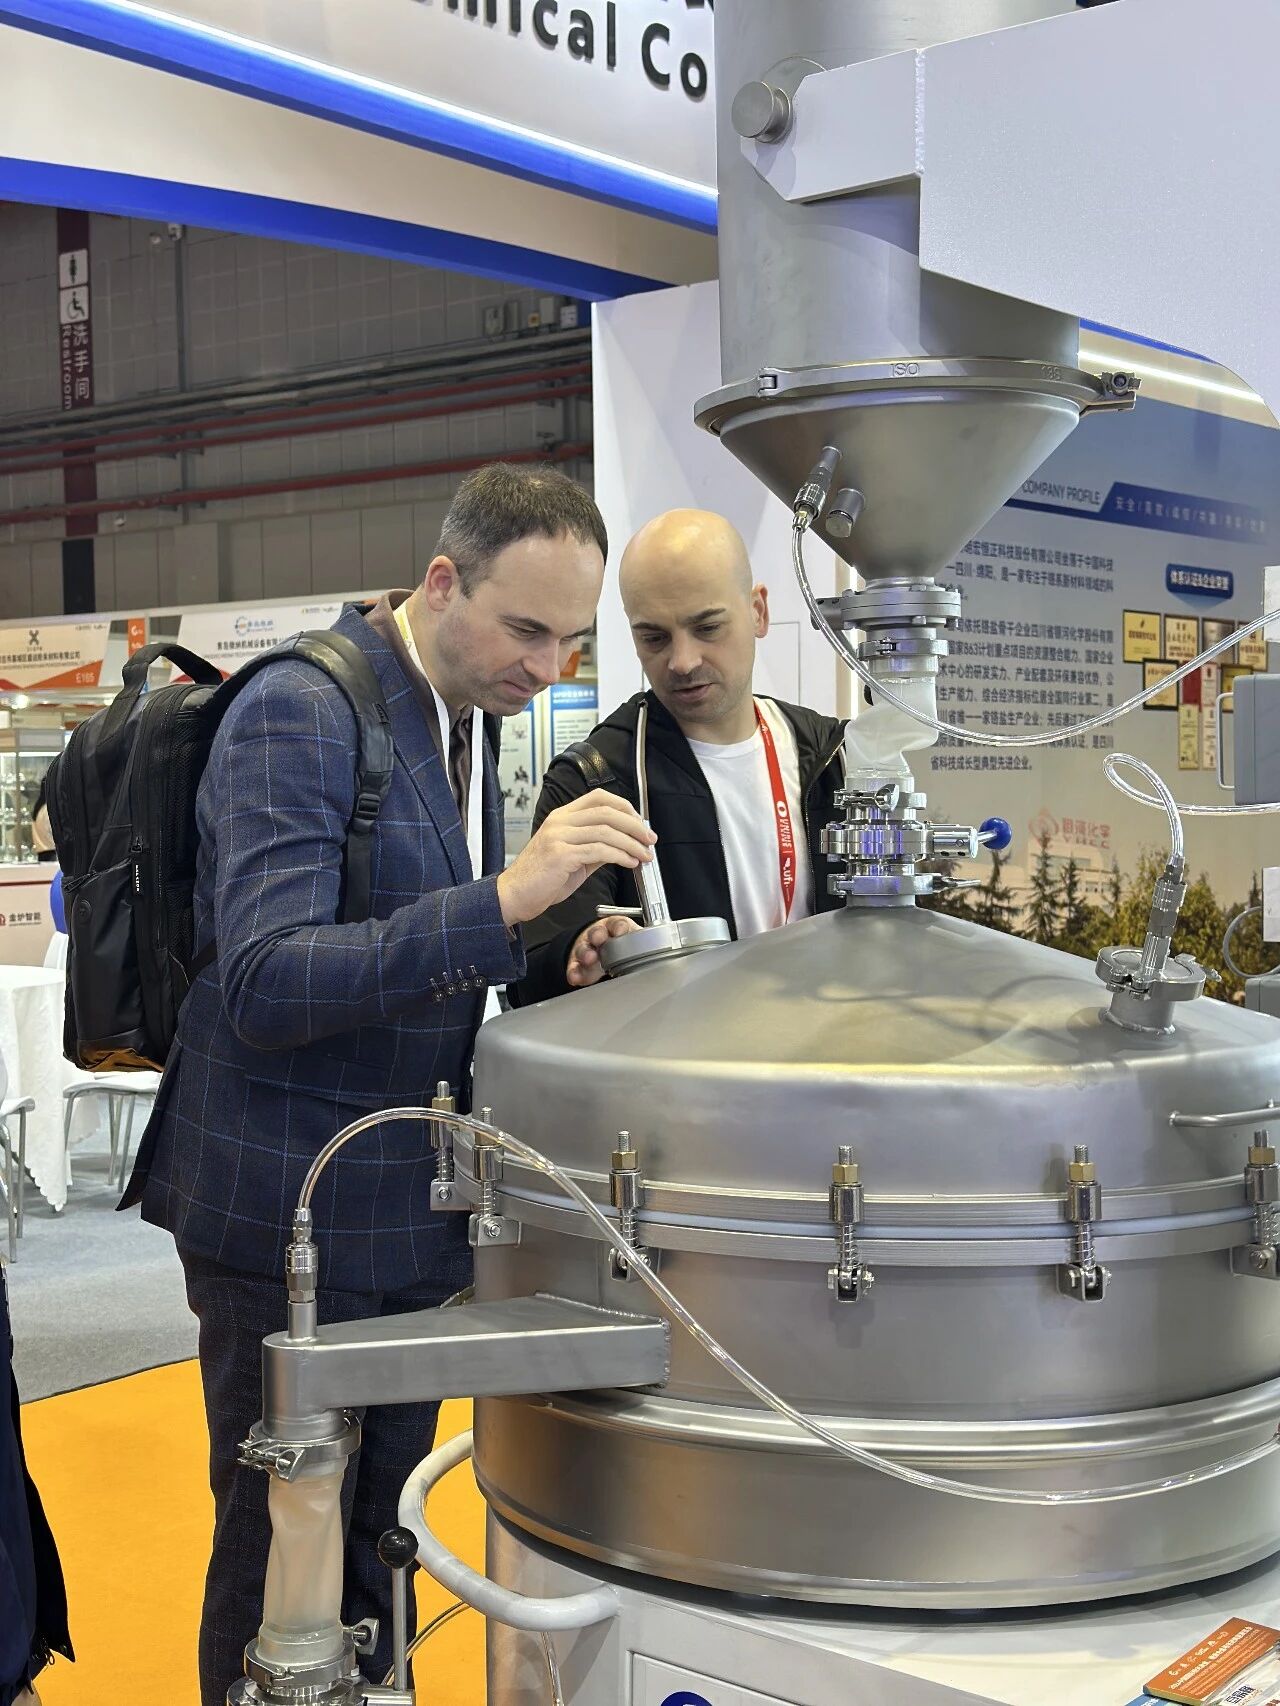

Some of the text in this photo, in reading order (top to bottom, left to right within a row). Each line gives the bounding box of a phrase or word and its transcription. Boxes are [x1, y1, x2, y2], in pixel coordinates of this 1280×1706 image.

[62, 324, 72, 410] Restroom
[73, 324, 90, 401] 洗手间
[890, 363, 920, 377] ISO
[1022, 479, 1100, 505] COMPANY PROFILE
